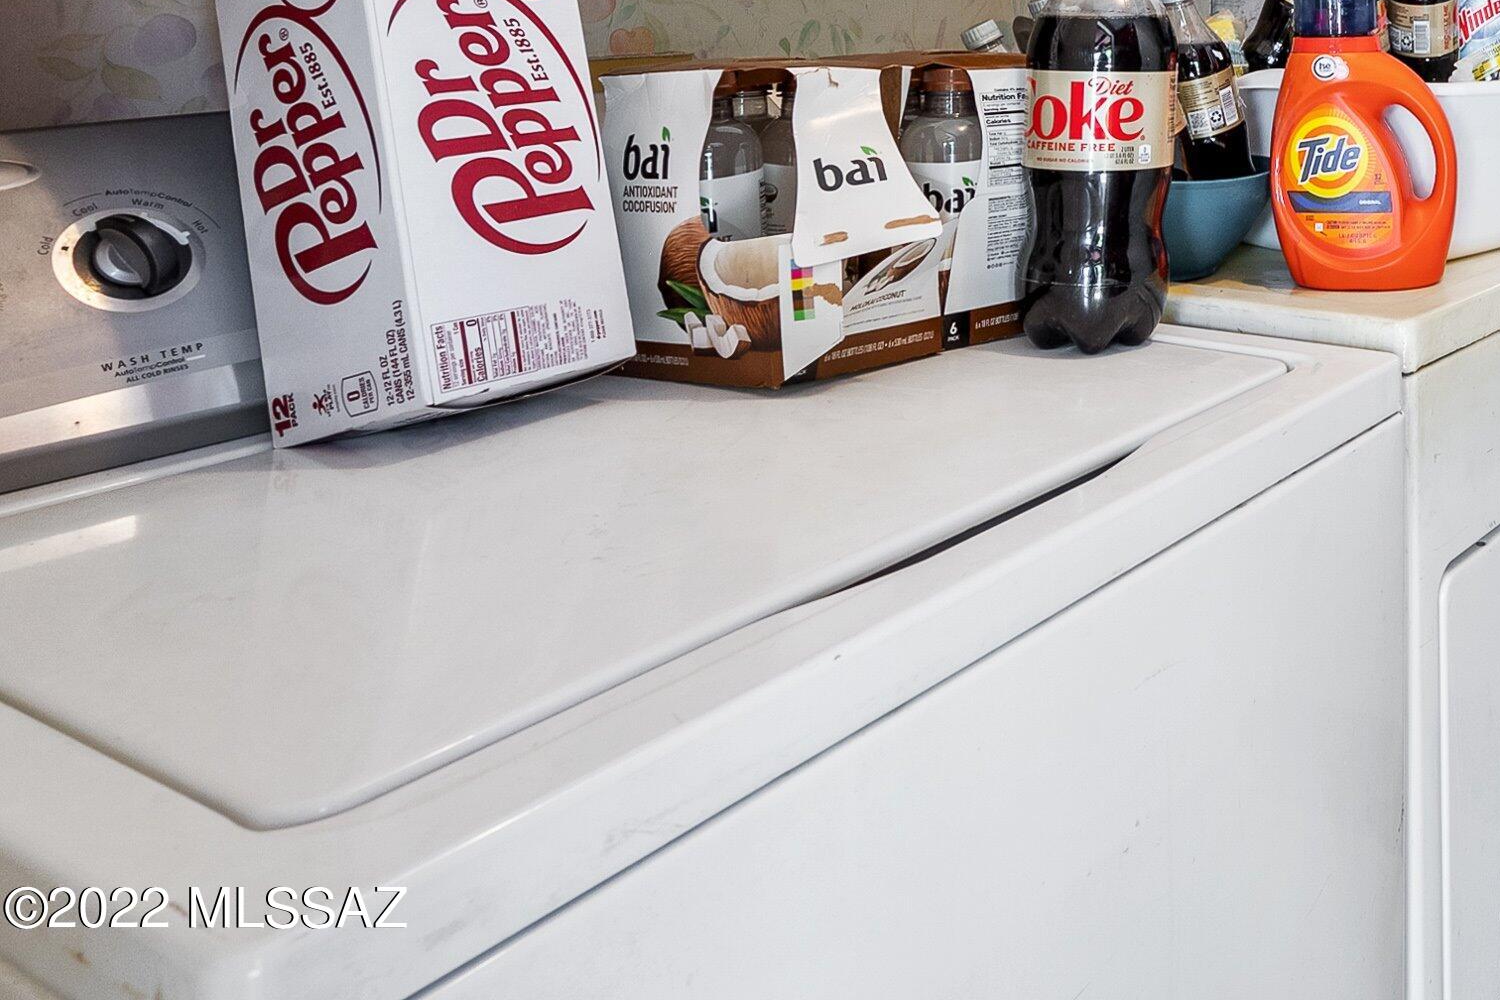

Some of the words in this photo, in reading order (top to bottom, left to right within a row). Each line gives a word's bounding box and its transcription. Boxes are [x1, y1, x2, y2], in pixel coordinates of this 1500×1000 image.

[981, 93, 1016, 101] Nutrition
[1088, 76, 1134, 96] Diet
[414, 58, 513, 163] Dr
[623, 128, 671, 180] bai
[1027, 140, 1075, 152] CAFFEINE
[250, 108, 312, 215] Dr
[258, 32, 379, 305] Pepper
[813, 147, 888, 192] bai
[1298, 135, 1361, 184] Tide
[131, 198, 165, 210] Warm
[623, 185, 678, 199] ANTIOXIDANT
[72, 202, 98, 217] Cool
[191, 218, 208, 234] Hot
[37, 236, 54, 256] Cold
[466, 319, 477, 327] 0
[949, 322, 958, 335] 6
[397, 328, 408, 353] CANS
[434, 325, 446, 350] Facts
[101, 355, 150, 372] WASH
[160, 342, 204, 359] TEMP
[379, 355, 389, 368] OZ
[388, 345, 398, 358] FL
[126, 375, 140, 383] ALL
[141, 369, 162, 379] COLD
[163, 364, 189, 375] RINSES
[382, 369, 391, 380] FL
[439, 351, 452, 390] Nutrition
[474, 347, 486, 382] Calories
[347, 390, 361, 402] 0
[359, 377, 370, 410] CALORIES
[384, 381, 395, 407] 12-12
[394, 379, 405, 404] CANS
[404, 370, 415, 401] 12-355
[272, 394, 292, 437] 12
[287, 392, 299, 427] PACK
